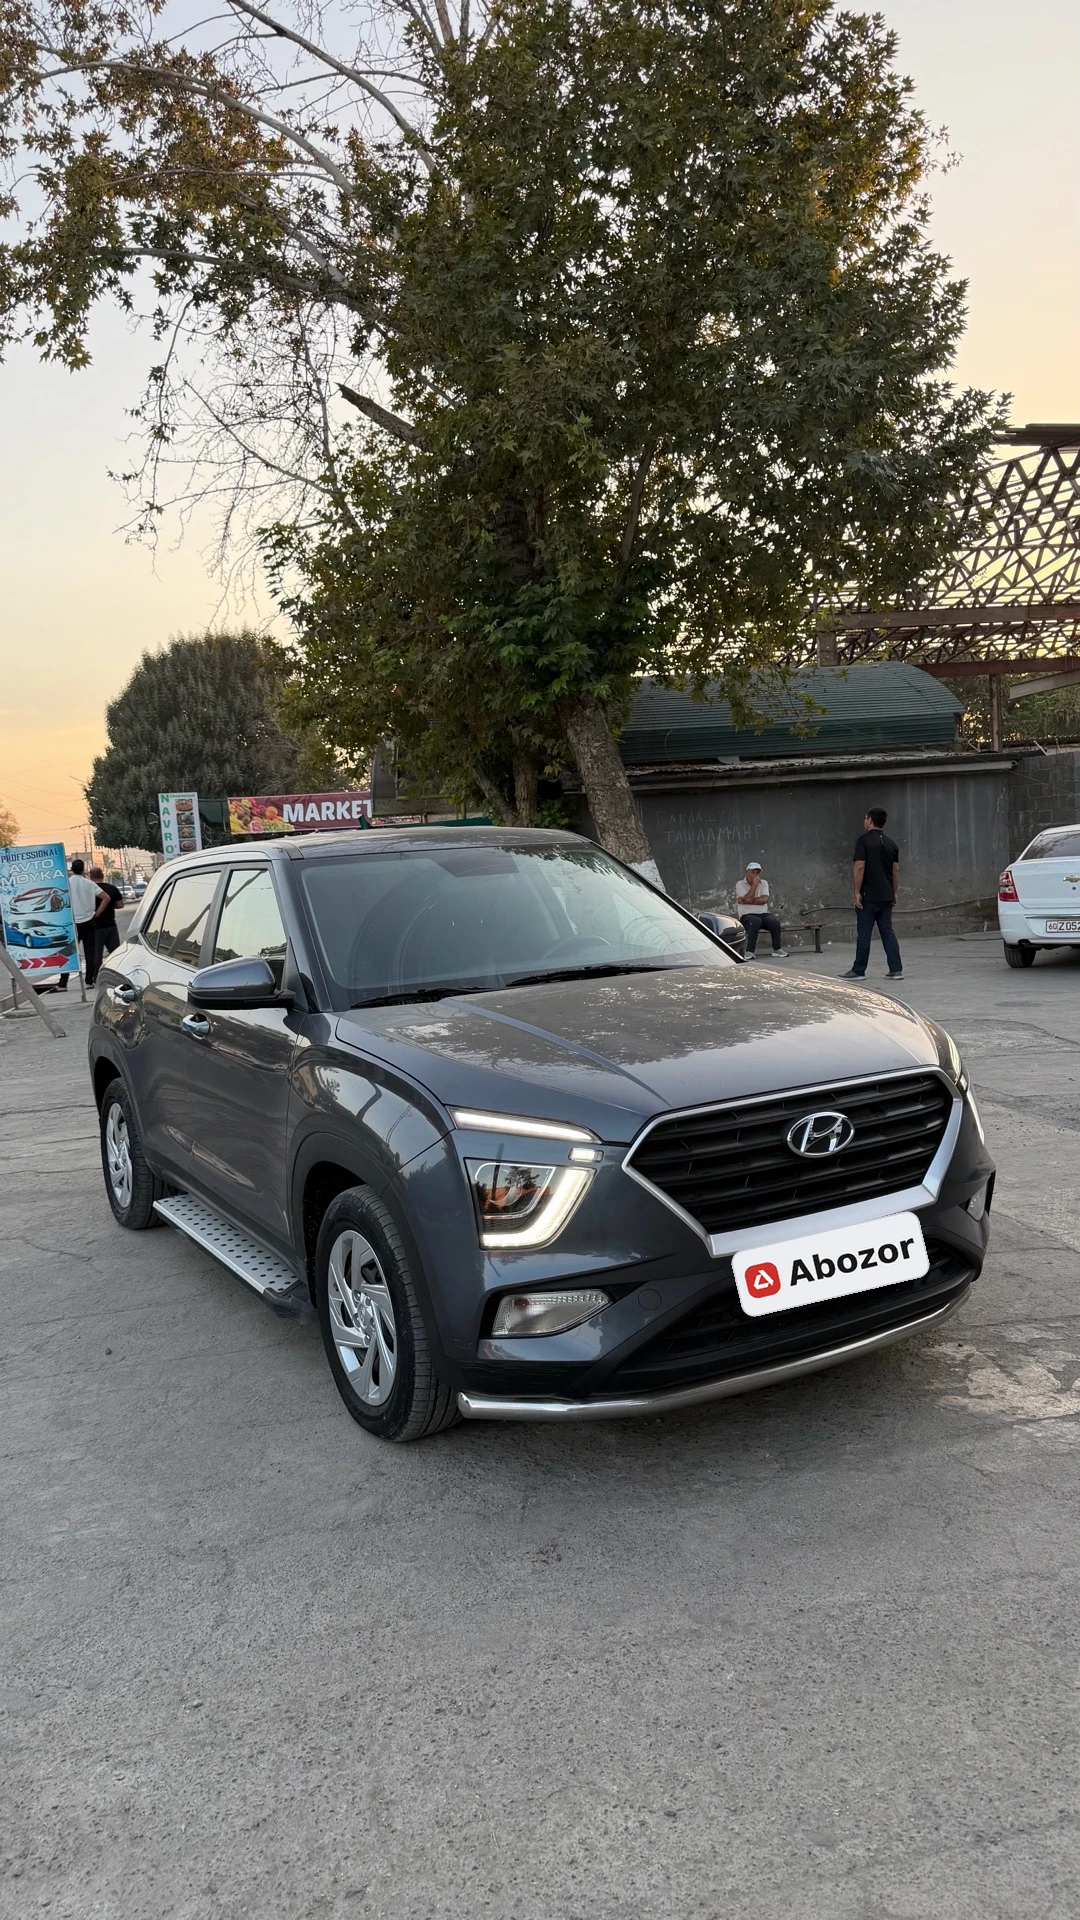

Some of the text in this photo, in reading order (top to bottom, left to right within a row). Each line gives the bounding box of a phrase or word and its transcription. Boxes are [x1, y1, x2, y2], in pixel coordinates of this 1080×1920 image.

[282, 799, 373, 823] MARKET
[10, 859, 54, 874] AVTO
[0, 869, 65, 886] MOYKA
